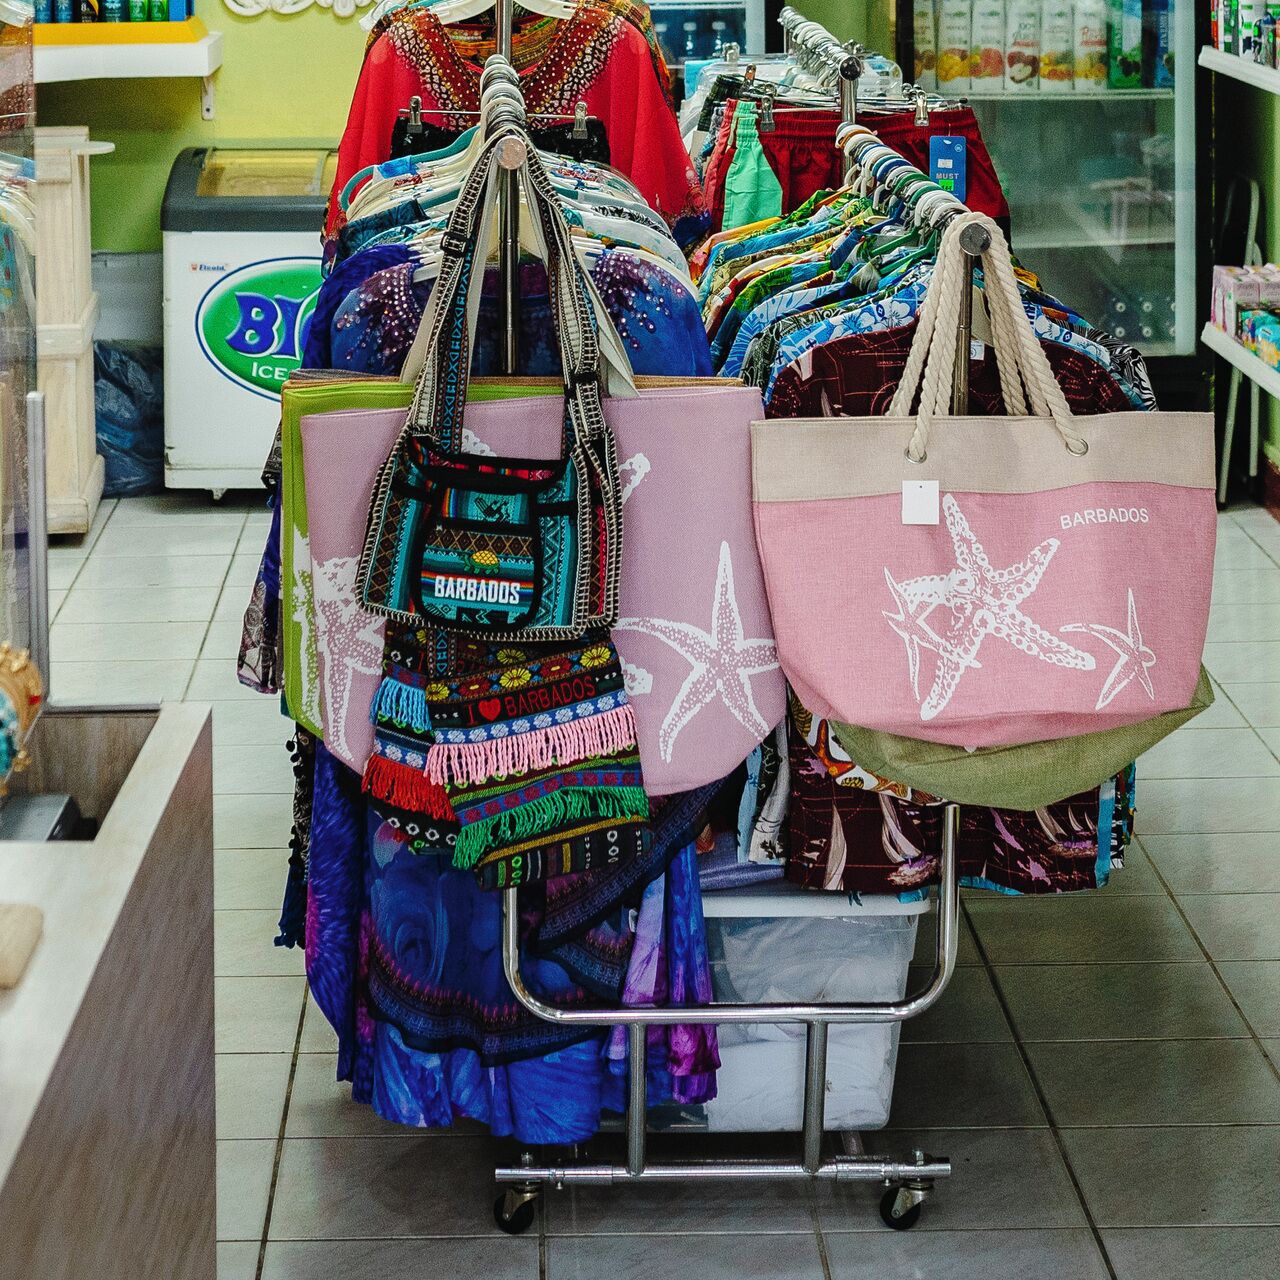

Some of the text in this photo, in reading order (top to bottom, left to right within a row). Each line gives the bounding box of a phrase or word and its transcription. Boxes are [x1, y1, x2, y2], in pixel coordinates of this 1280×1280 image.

[251, 362, 290, 379] ICE
[1060, 507, 1149, 529] BARBADOS
[434, 575, 521, 605] BARBADOS
[504, 675, 597, 718] BARBADOS
